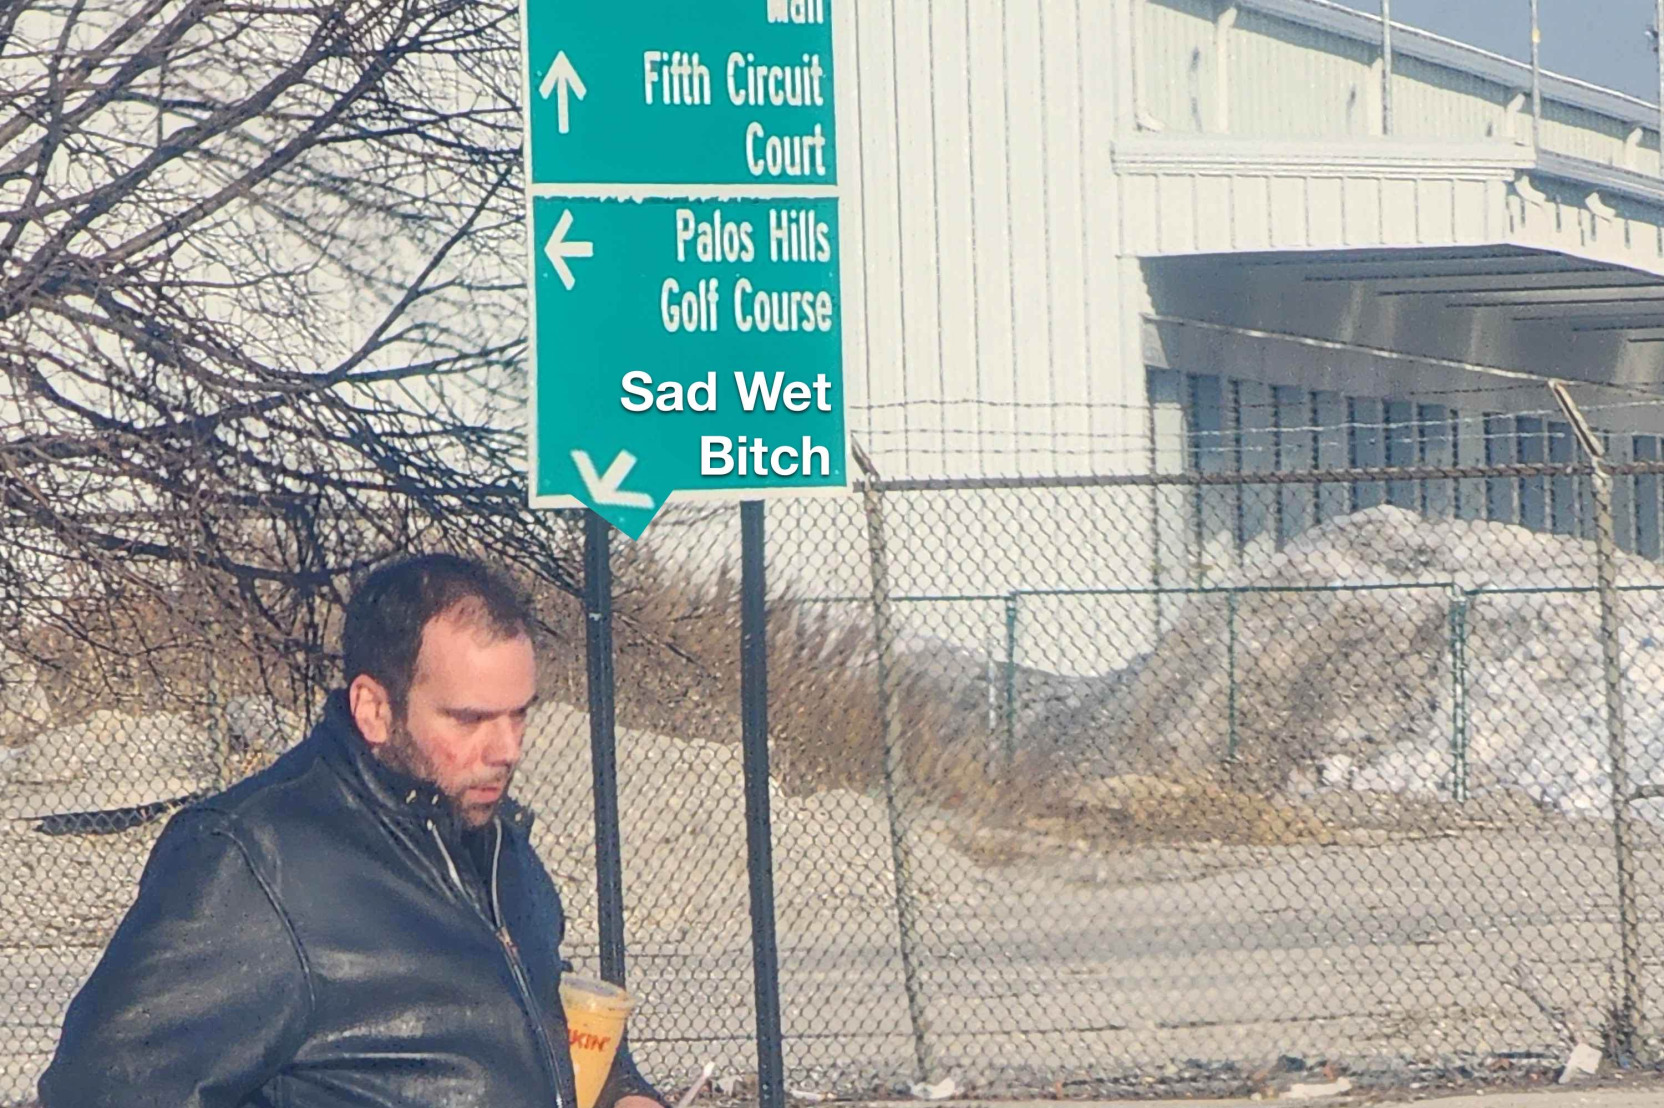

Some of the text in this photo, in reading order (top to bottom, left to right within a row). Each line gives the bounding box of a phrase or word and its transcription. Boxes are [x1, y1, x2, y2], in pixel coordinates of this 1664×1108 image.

[643, 50, 824, 106] Fifth Circuit
[744, 121, 826, 176] Court
[675, 208, 830, 263] Palos Hills
[660, 277, 832, 333] Golf Course
